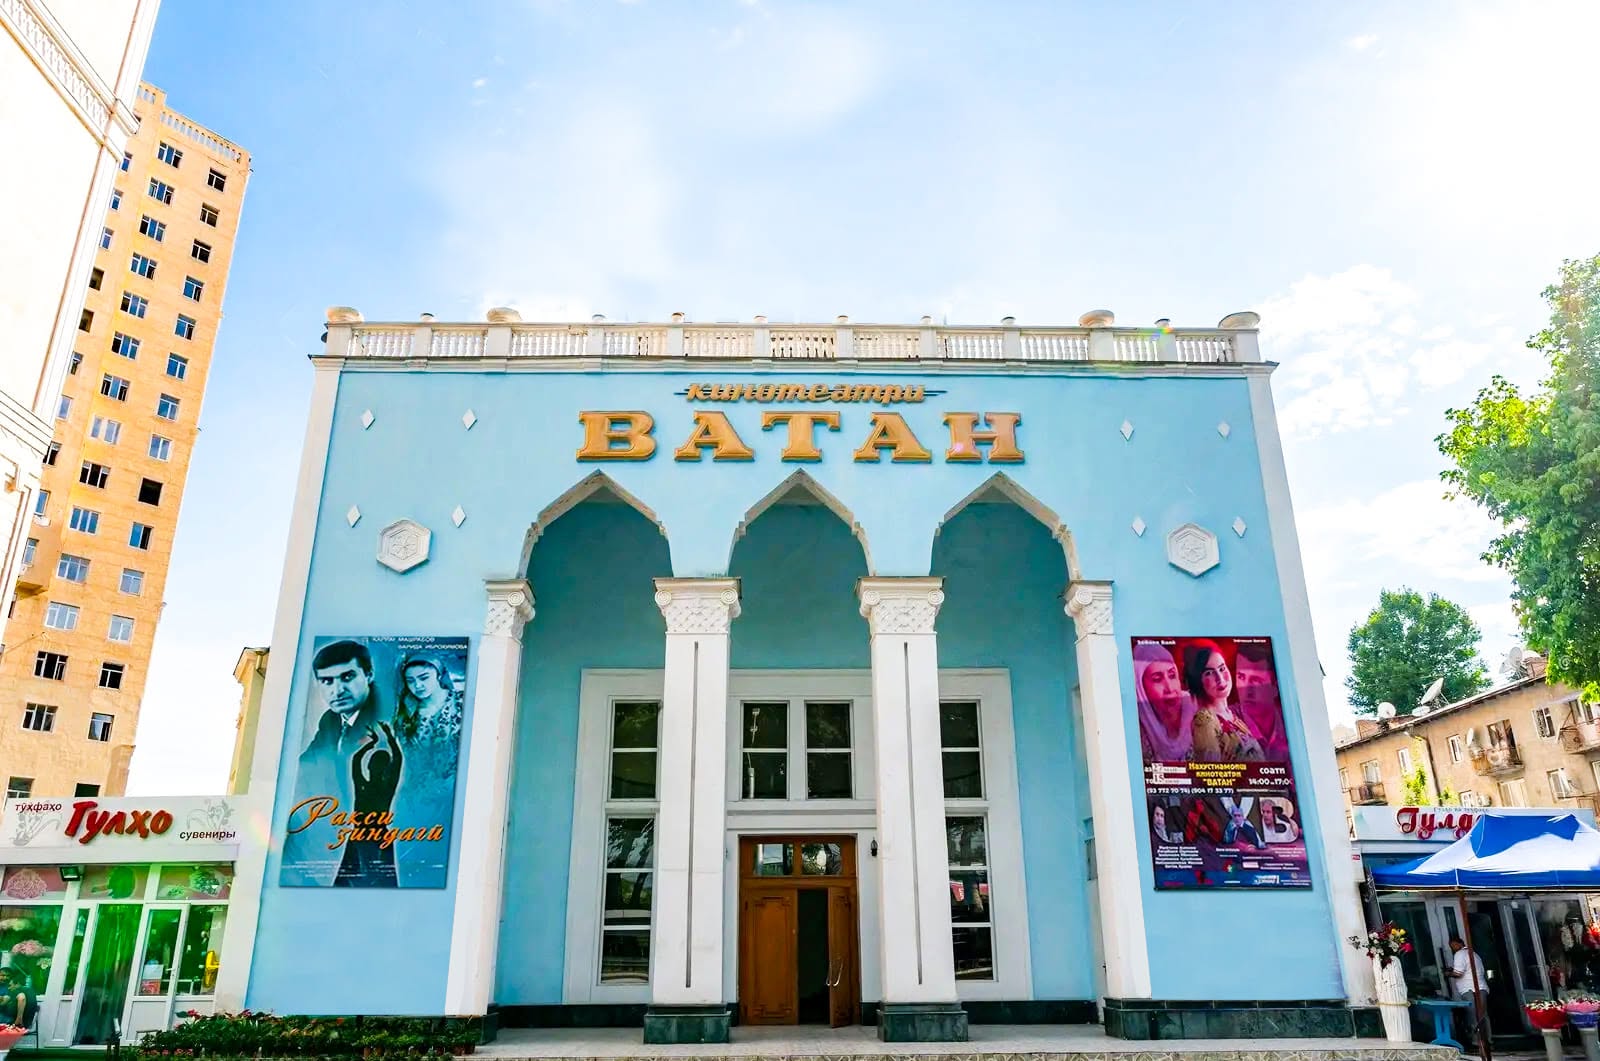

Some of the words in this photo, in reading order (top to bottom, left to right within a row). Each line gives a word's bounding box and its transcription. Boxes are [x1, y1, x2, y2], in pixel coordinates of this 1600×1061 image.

[685, 383, 926, 407] кинотеатри
[576, 410, 1025, 462] ВАТАН
[179, 830, 236, 842] сувениры
[1397, 807, 1482, 839] Гулд
